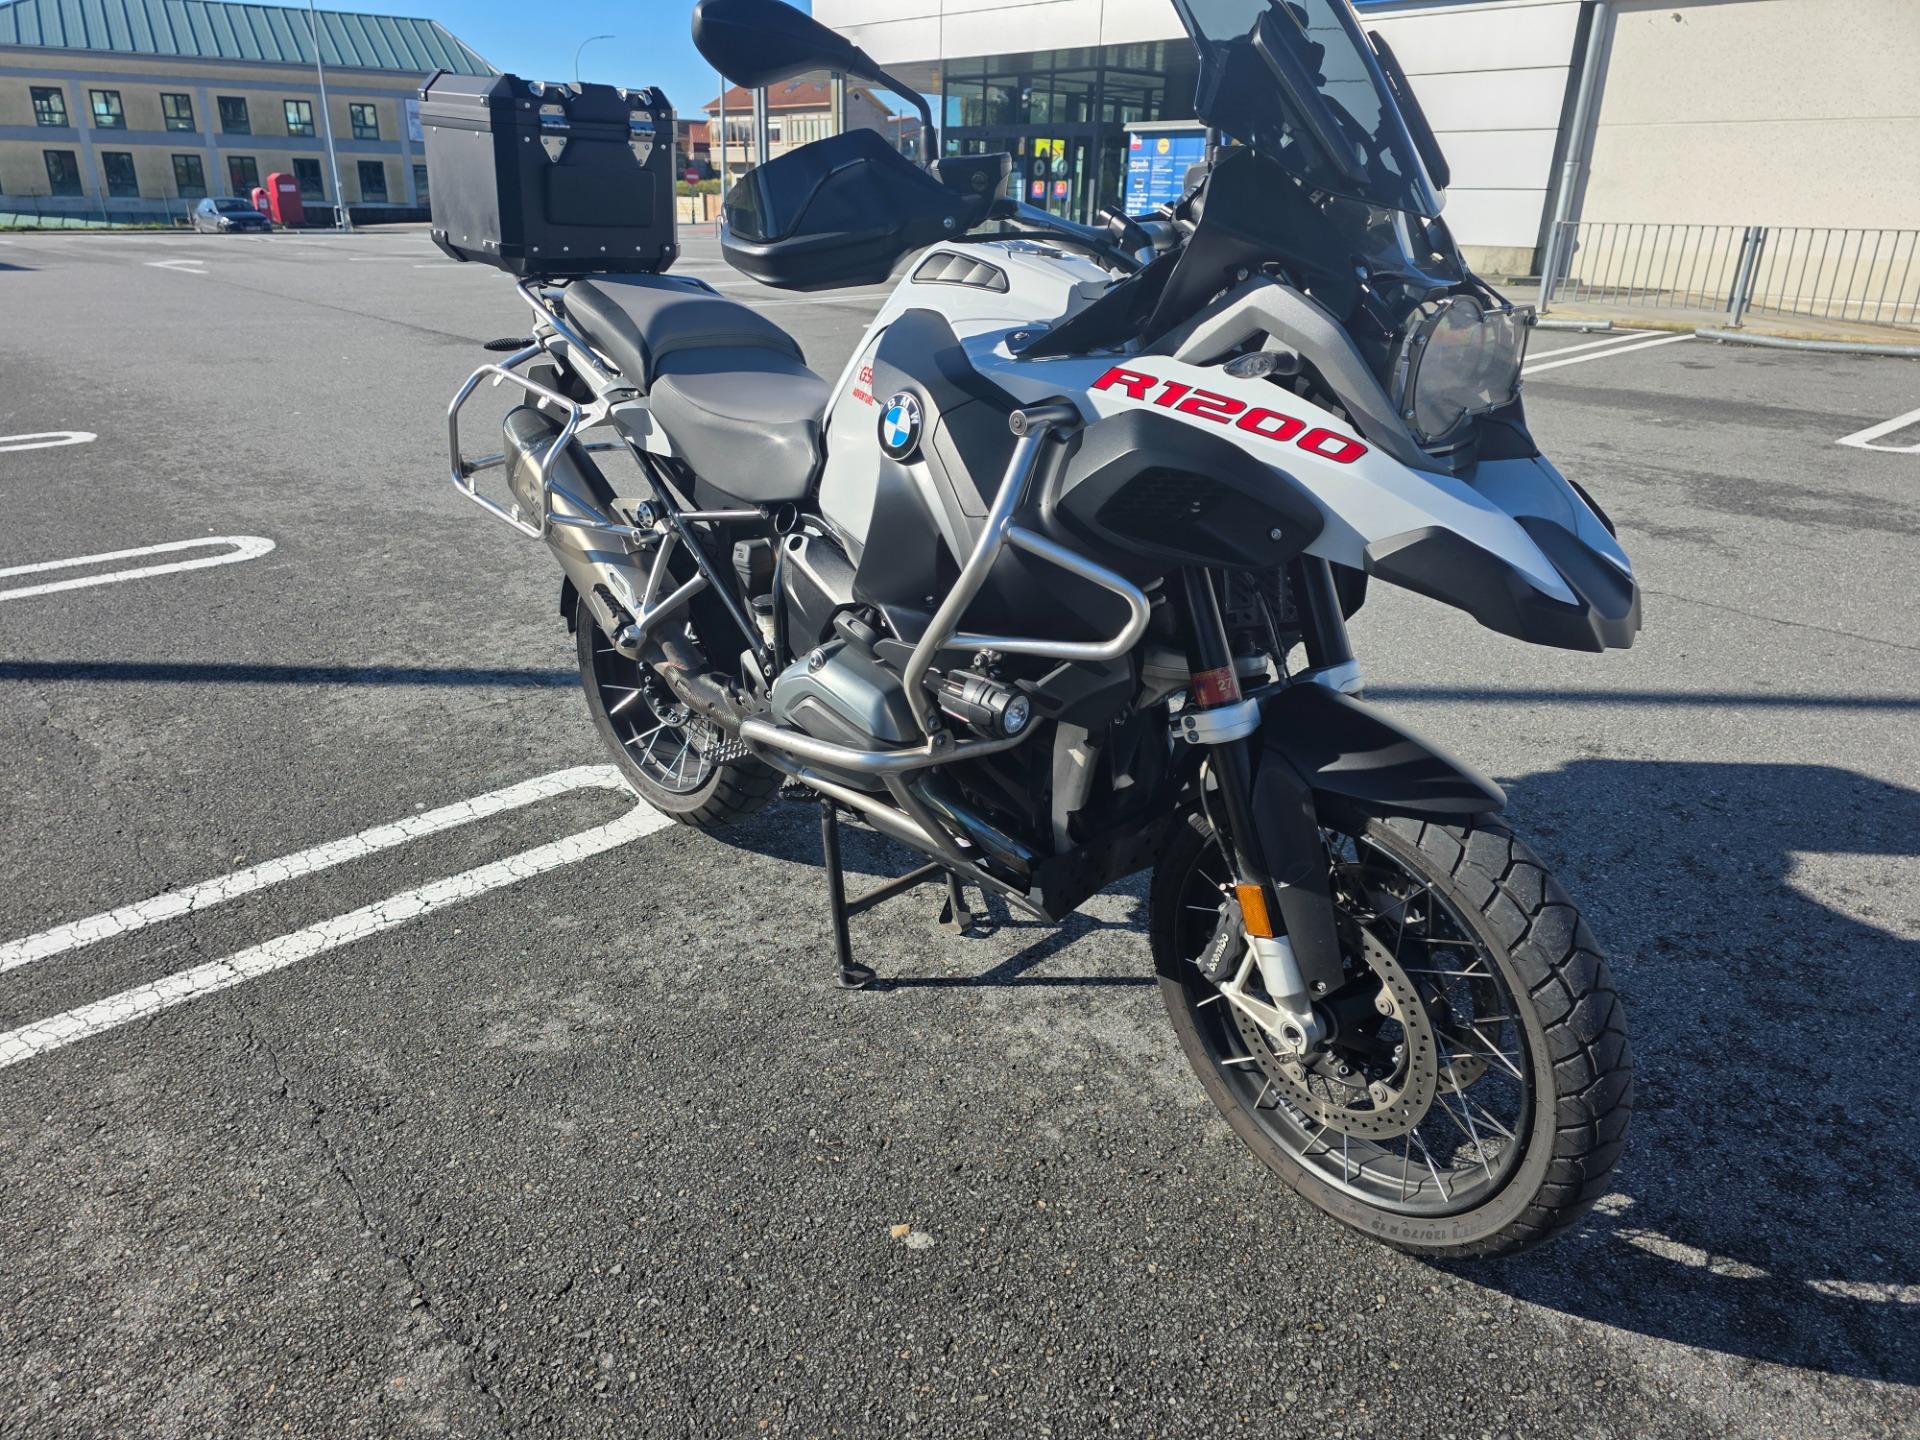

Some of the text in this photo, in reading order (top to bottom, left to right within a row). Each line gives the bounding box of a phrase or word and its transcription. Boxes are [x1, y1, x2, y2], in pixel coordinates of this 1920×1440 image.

[888, 396, 919, 424] BMW
[1092, 366, 1369, 464] R1200
[1206, 933, 1229, 972] brembo
[1390, 1226, 1399, 1235] R
[1402, 1228, 1446, 1240] 120/70
